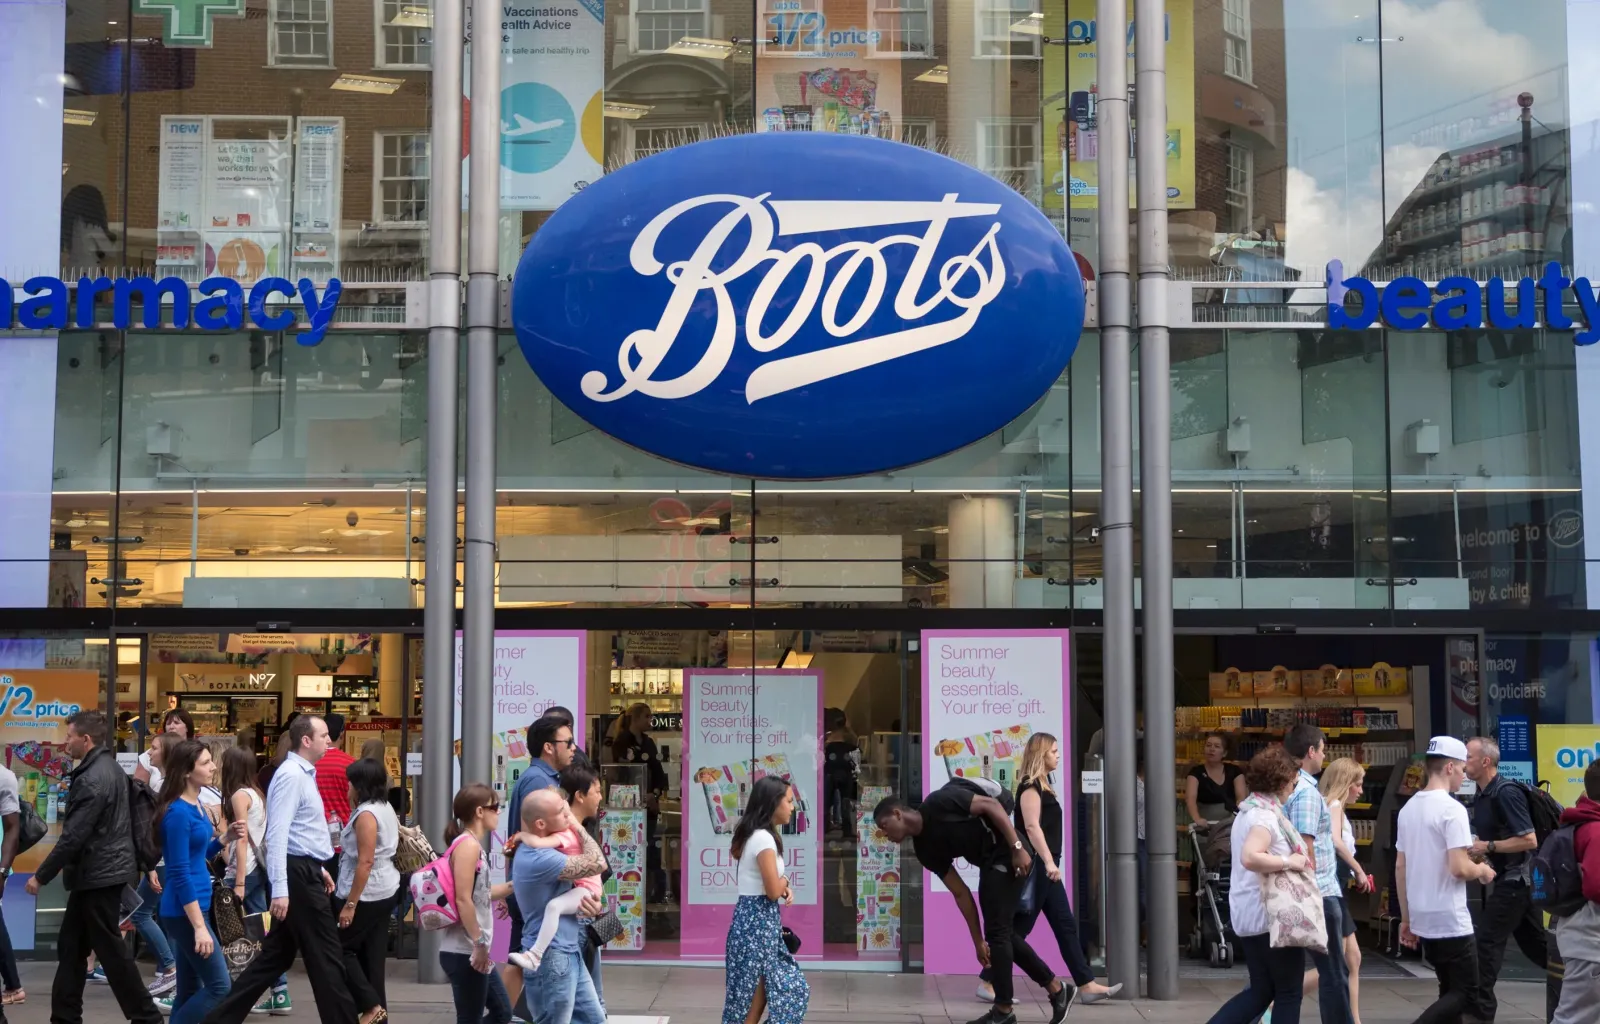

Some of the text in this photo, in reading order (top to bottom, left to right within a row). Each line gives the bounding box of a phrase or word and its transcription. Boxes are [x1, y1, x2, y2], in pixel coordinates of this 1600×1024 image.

[503, 7, 579, 17] Vaccinations
[775, 1, 800, 10] up to
[501, 20, 571, 30] ealth Advice
[769, 12, 880, 48] 1/2 price
[512, 47, 528, 55] safe
[546, 47, 574, 56] healthy
[170, 124, 200, 134] new
[218, 164, 243, 172] works
[580, 191, 1006, 405] Boots
[1524, 523, 1541, 541] to
[1489, 586, 1498, 600] &
[1501, 583, 1530, 599] child
[941, 644, 1010, 661] Summer
[941, 663, 996, 681] beauty
[3, 676, 12, 684] to
[701, 682, 762, 697] Summer
[941, 682, 1023, 697] essentials.
[1488, 682, 1546, 700] Opticians
[36, 701, 80, 719] price
[701, 698, 749, 714] beauty
[942, 699, 979, 715] Your
[1018, 700, 1046, 718] gift.
[15, 720, 38, 728] holiday
[701, 714, 773, 728] essentials.
[701, 730, 734, 744] Your
[768, 730, 792, 747] gift.
[1498, 764, 1511, 773] help
[241, 940, 263, 954] Rock
